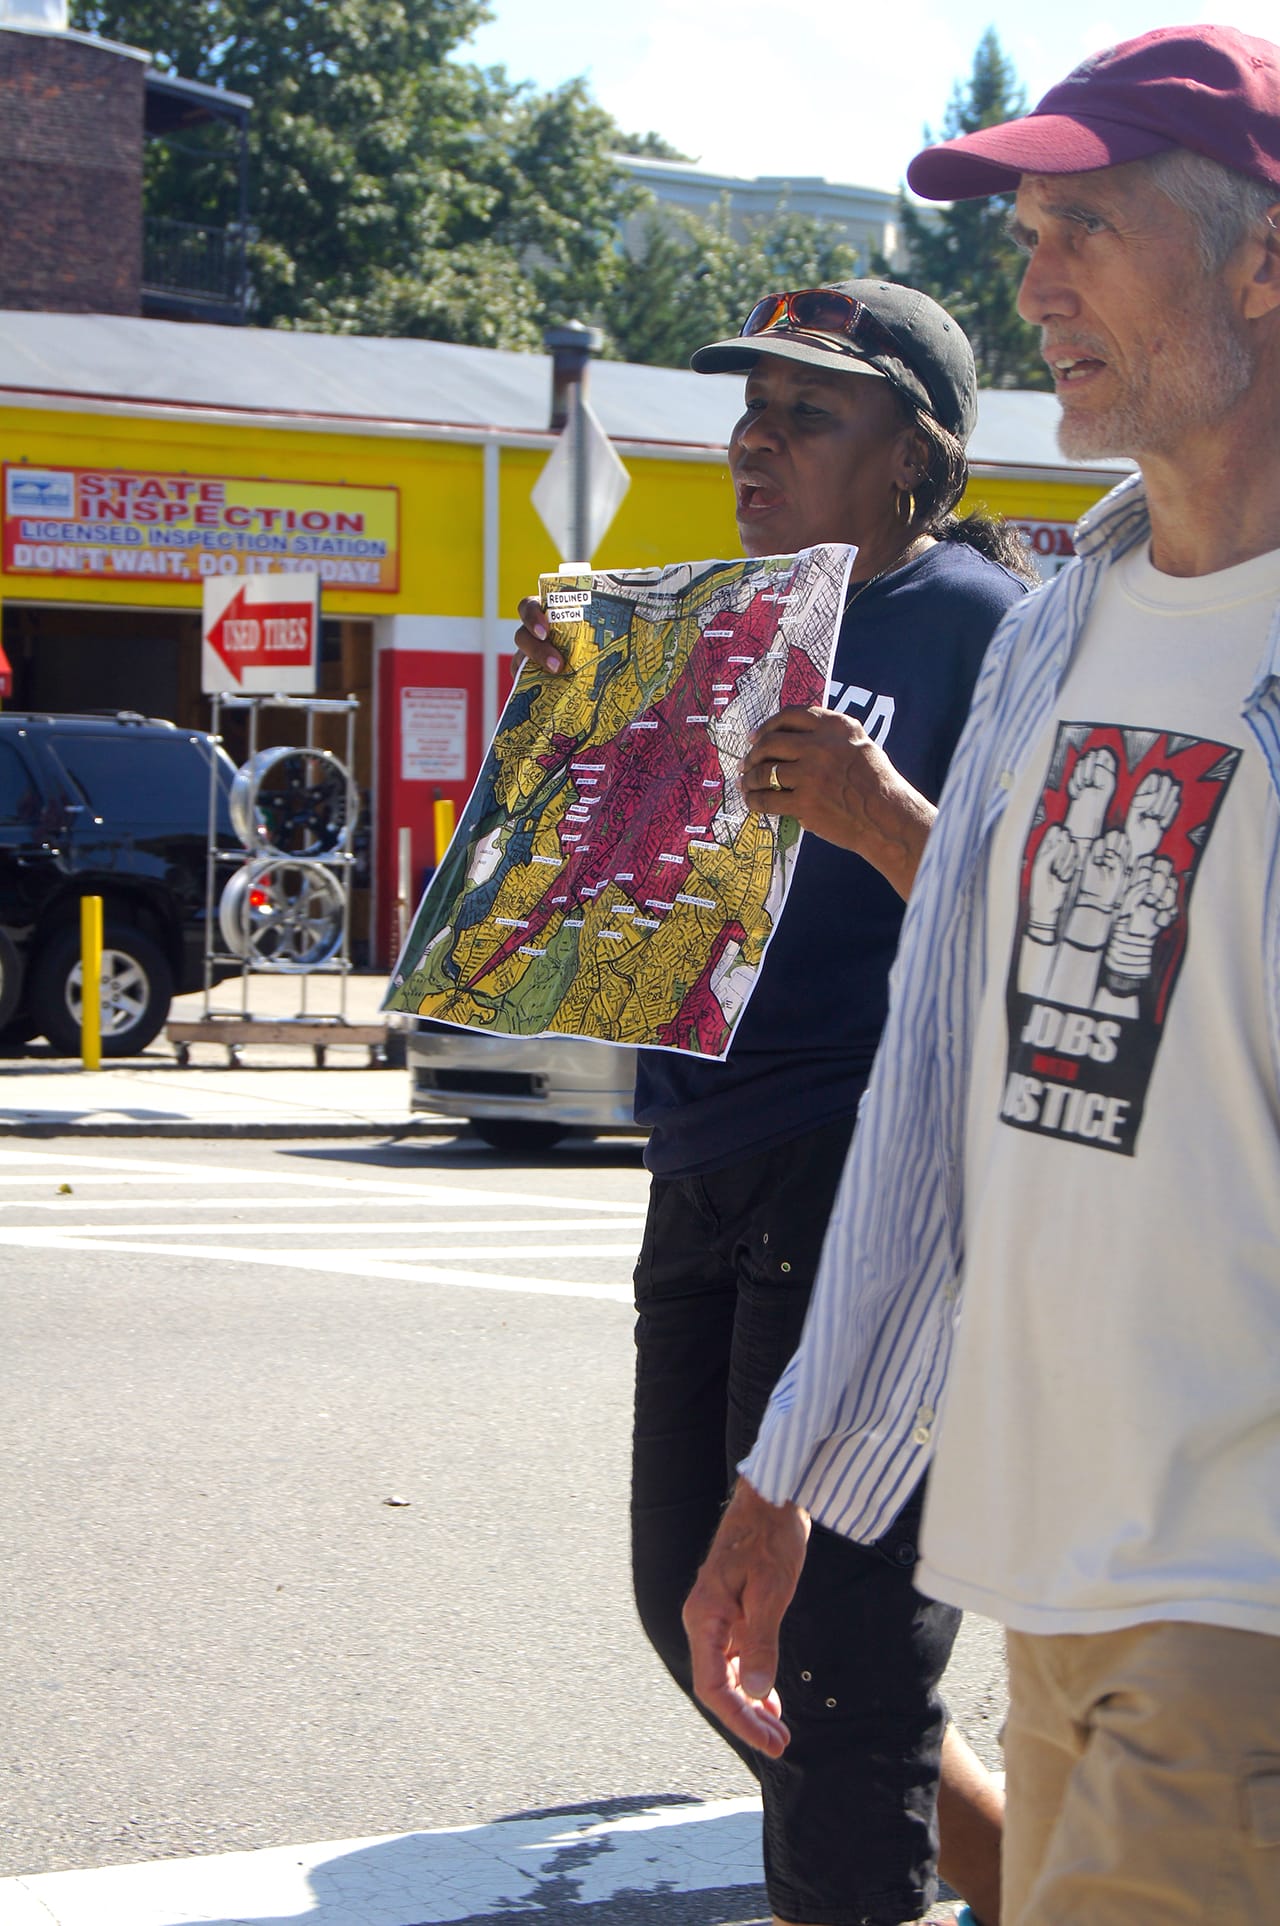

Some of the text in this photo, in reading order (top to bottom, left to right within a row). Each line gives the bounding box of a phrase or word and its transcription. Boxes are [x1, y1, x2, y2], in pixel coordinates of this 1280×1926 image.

[79, 474, 225, 504] STATE
[79, 499, 365, 534] INSPECTION
[21, 520, 388, 558] LICENSED INSPECTION STATION
[13, 543, 382, 584] DON'T WAIT, DO IT TODAY!
[549, 592, 589, 604] REDLINED
[551, 610, 581, 621] BOSTON
[223, 616, 308, 652] USED TIRES
